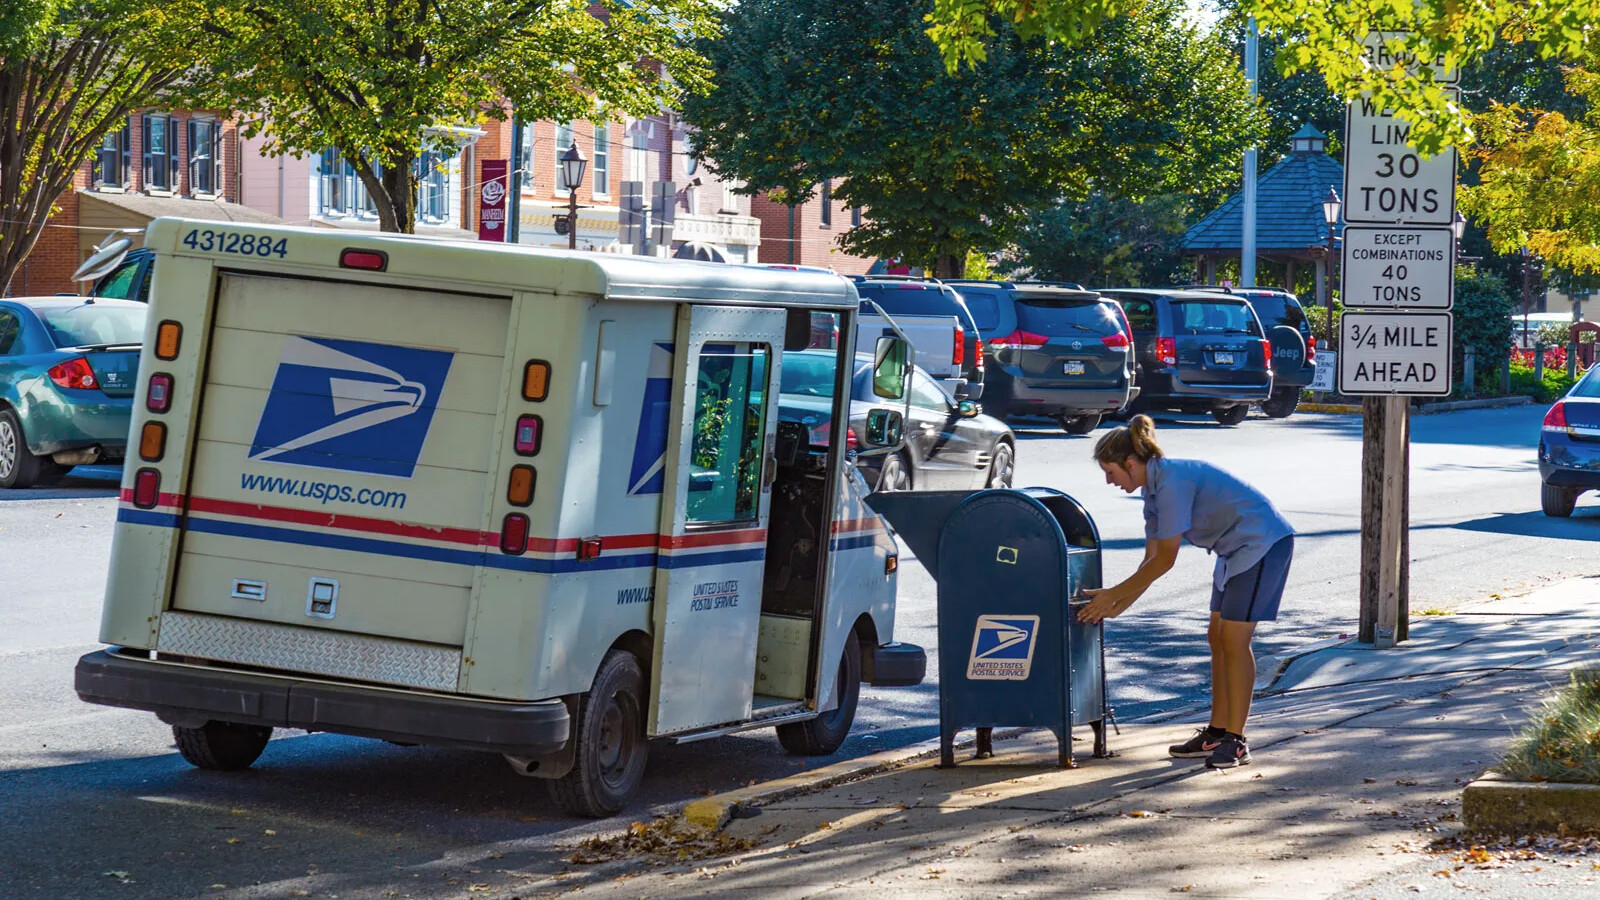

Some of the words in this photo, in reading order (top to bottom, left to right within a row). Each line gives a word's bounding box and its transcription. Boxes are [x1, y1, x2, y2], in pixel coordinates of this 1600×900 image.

[1360, 45, 1447, 66] BRIDE
[1372, 125, 1418, 145] LIM
[1375, 153, 1420, 179] 30
[1360, 187, 1438, 213] TONS
[183, 229, 288, 258] 4312884
[1374, 234, 1422, 245] EXCEPT
[1352, 249, 1444, 261] COMBINATIONS
[1382, 265, 1408, 280] 40
[1373, 286, 1421, 301] TONS
[1384, 326, 1438, 347] MILE
[1273, 346, 1299, 359] Jeep
[1354, 362, 1437, 383] AHEAD
[241, 473, 406, 509] www.usps.com
[693, 583, 716, 597] UNITED
[717, 580, 738, 593] STATES
[691, 598, 712, 611] POSTAL
[714, 595, 739, 609] SERVICE
[998, 669, 1025, 677] SERVICE
